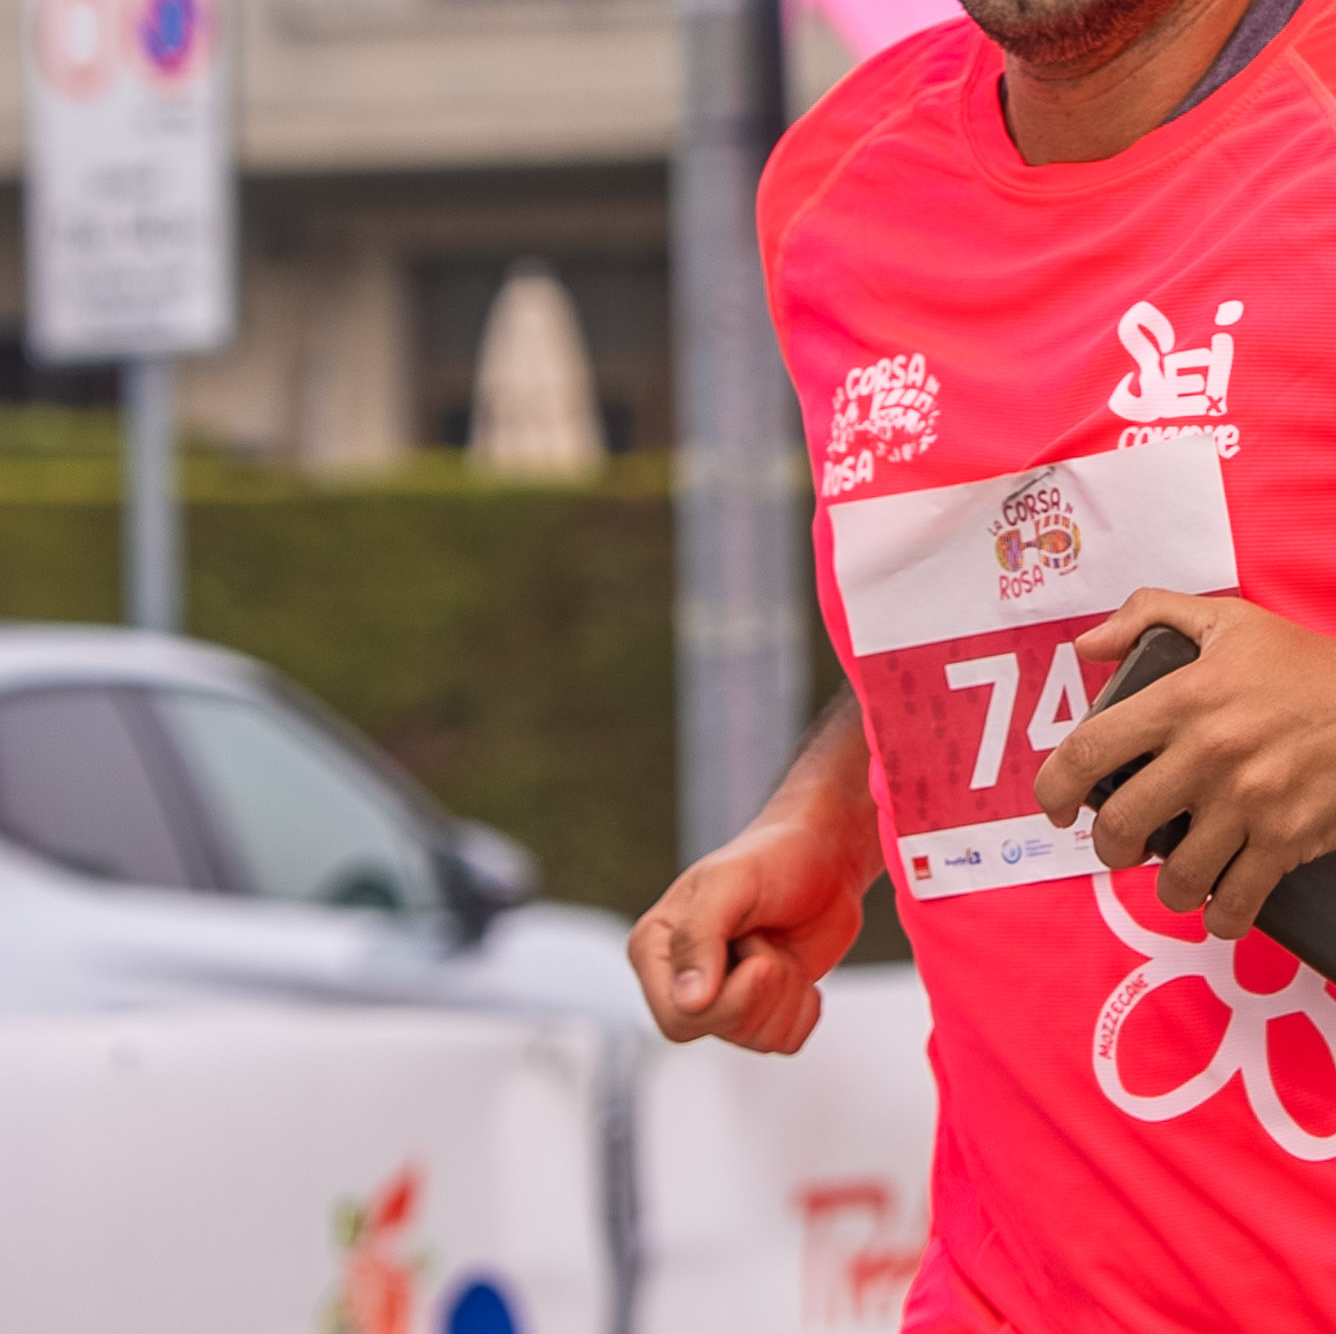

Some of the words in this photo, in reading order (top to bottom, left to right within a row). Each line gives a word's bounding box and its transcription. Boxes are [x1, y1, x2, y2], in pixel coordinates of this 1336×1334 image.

[845, 353, 925, 399] CORSA
[1002, 488, 1061, 526] CORSA
[998, 564, 1045, 600] ROSA
